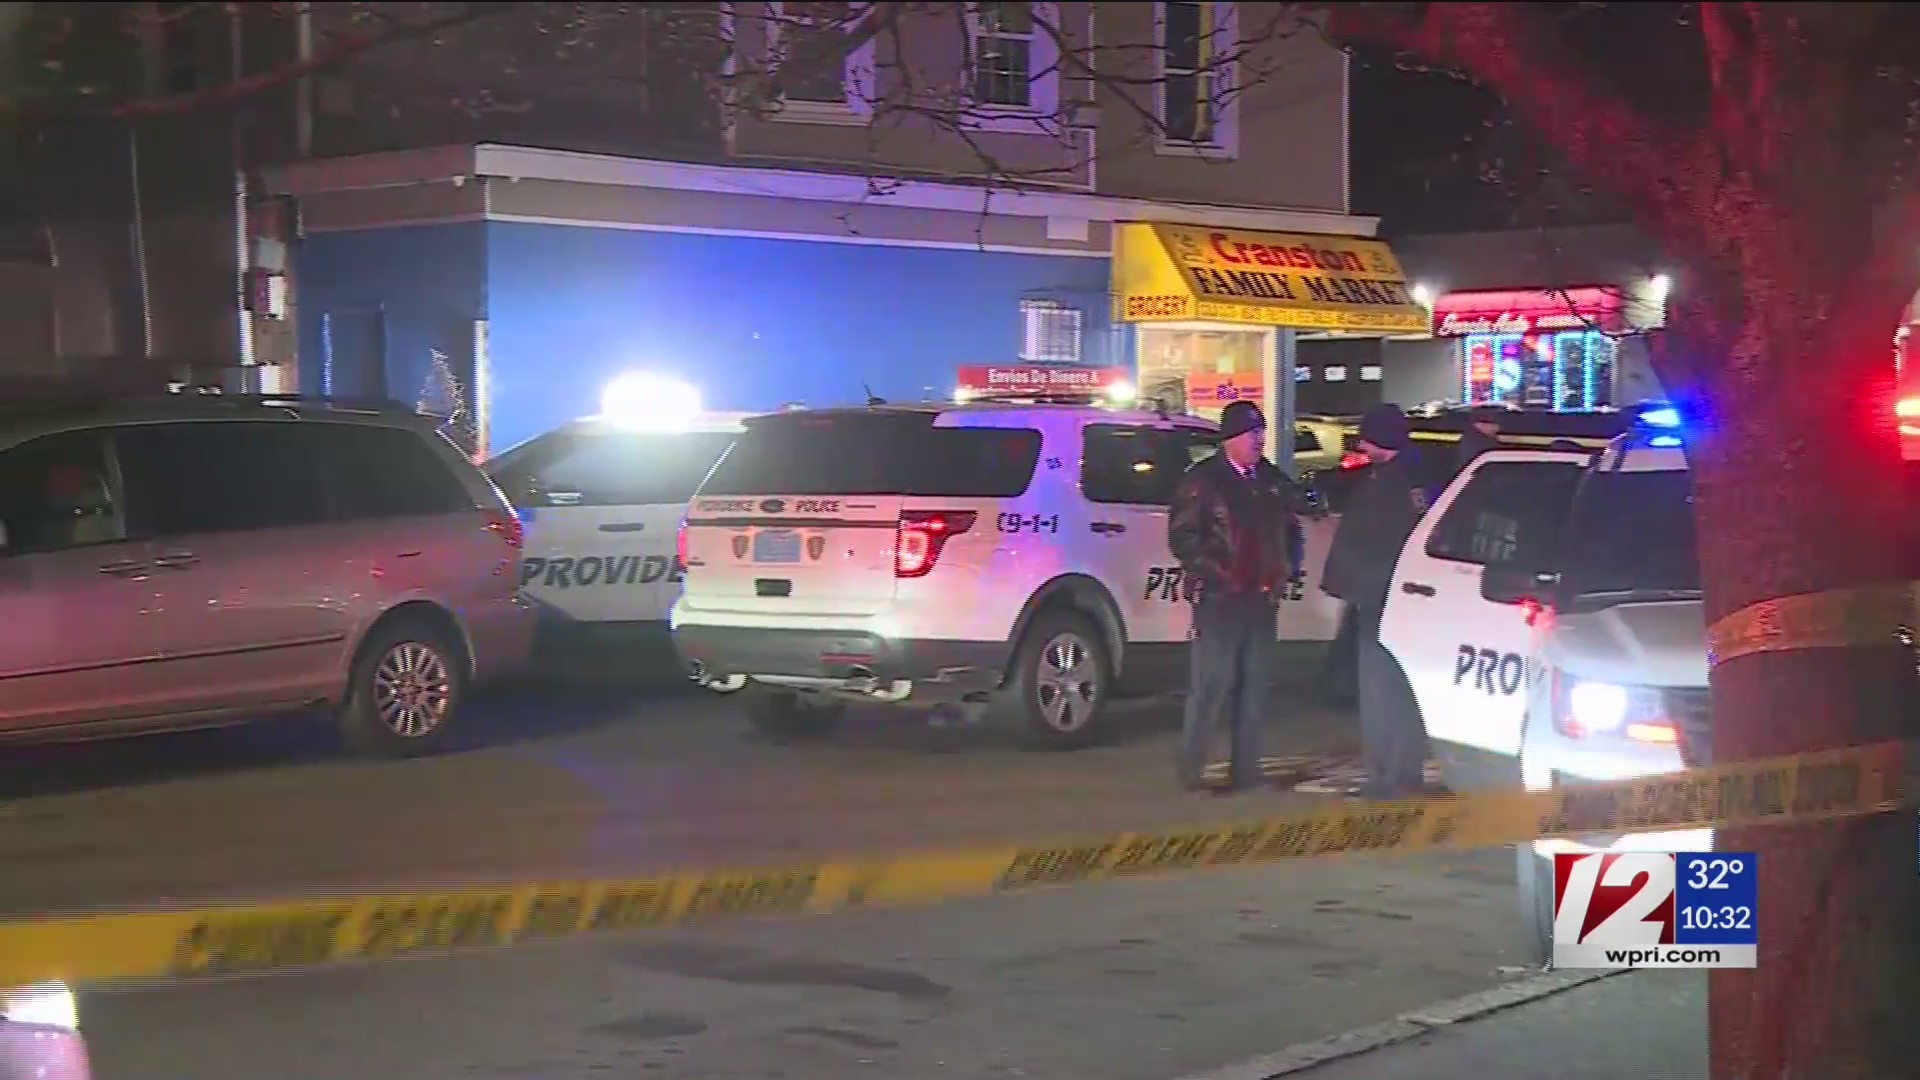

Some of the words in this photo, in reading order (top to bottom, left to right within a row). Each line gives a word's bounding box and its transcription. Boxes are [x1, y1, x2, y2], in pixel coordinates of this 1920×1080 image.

[1209, 232, 1366, 273] Cranston
[1188, 266, 1297, 300] FAMILY
[1126, 295, 1187, 317] GROCERY
[988, 369, 1028, 384] Envios
[1030, 370, 1047, 384] De
[1049, 370, 1087, 385] Dinero
[1089, 371, 1099, 385] A
[795, 501, 840, 513] POLICE
